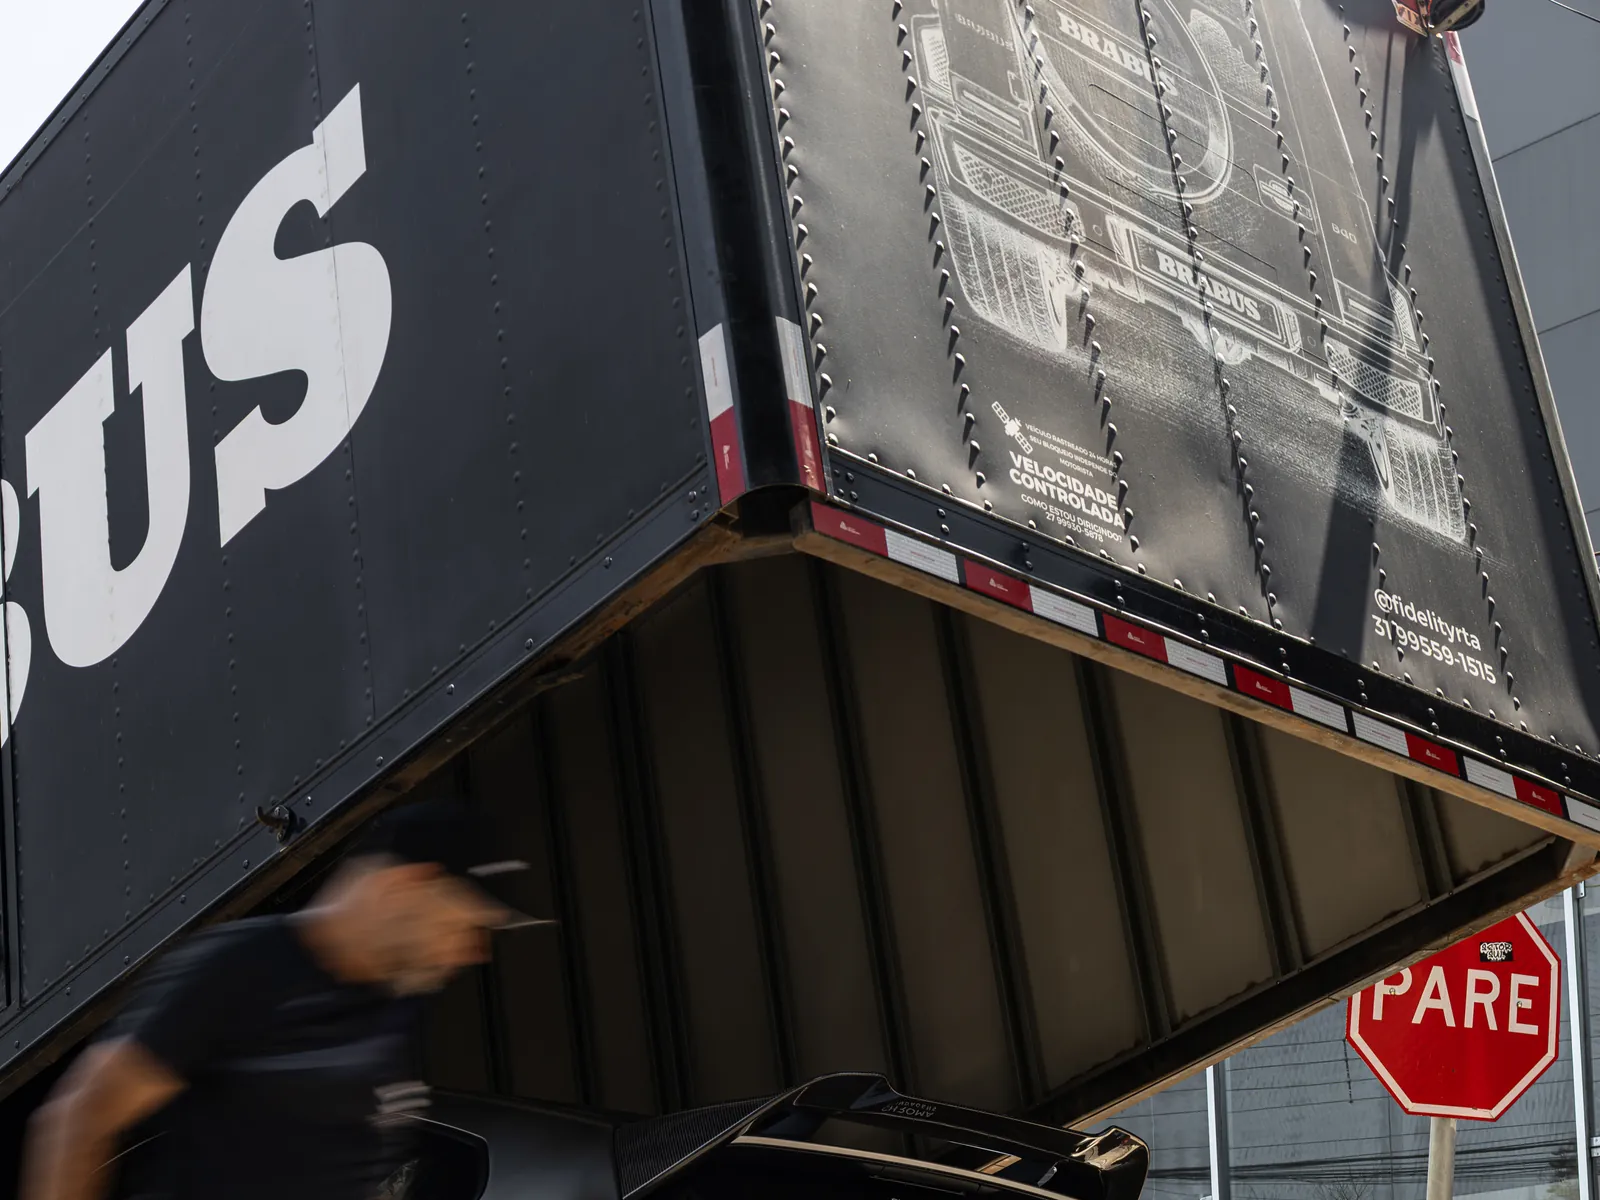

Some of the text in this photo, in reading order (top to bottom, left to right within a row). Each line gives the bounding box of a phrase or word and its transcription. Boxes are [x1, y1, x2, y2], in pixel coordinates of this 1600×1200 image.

[1155, 249, 1261, 321] BRABUS
[0, 83, 393, 748] US
[1029, 434, 1042, 446] SEU
[1042, 440, 1074, 459] BLOQUEIO
[1073, 453, 1109, 475] INDEPENDE
[1051, 434, 1089, 456] RASTREADO
[1088, 450, 1097, 460] 24
[1059, 457, 1094, 478] MOTORISTA
[1008, 450, 1119, 511] VELOCIDADE
[1009, 468, 1126, 530] CONTROLADA
[1020, 493, 1123, 543] COMO ESTOU DIRIGINDO?
[1045, 511, 1104, 543] 27 99930-5878
[1371, 614, 1497, 685] 31 99559-1515
[1374, 588, 1482, 652] @fidelityrta
[1372, 965, 1540, 1036] PARE
